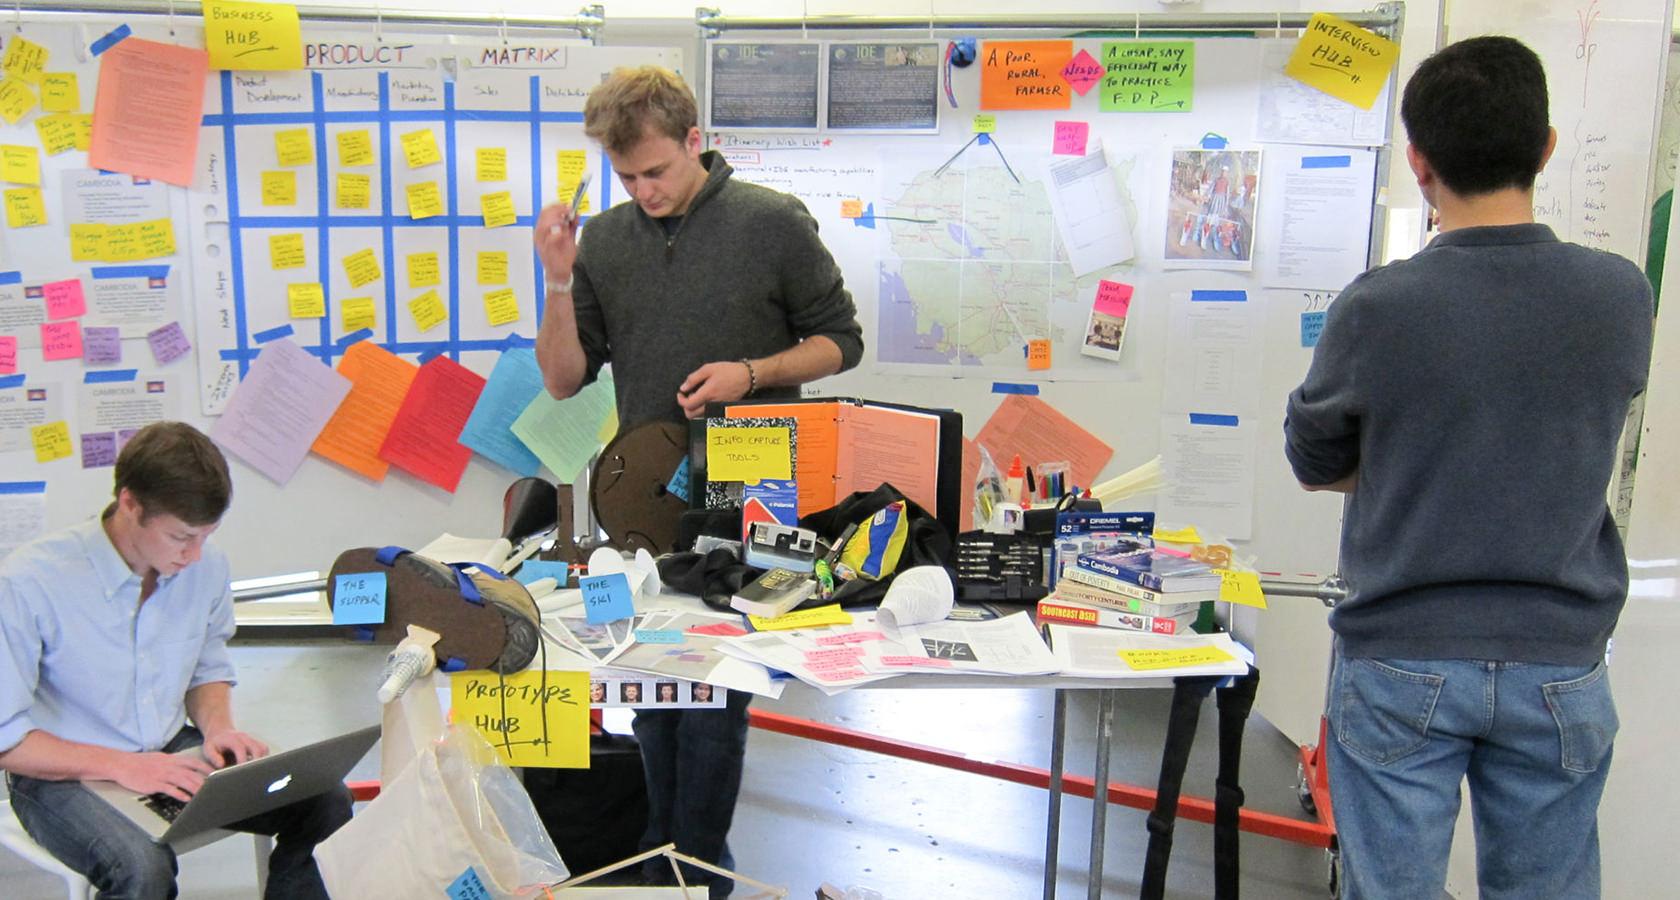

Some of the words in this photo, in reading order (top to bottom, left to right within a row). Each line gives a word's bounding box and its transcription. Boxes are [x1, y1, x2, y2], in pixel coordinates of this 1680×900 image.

[225, 30, 261, 45] HUB
[1313, 20, 1381, 57] INTERVIEW
[304, 44, 414, 66] PRODUCT
[481, 47, 560, 65] MATRIX
[988, 50, 998, 66] A
[1108, 47, 1117, 57] A
[1311, 44, 1353, 68] HUB
[1064, 61, 1100, 76] NEEDS
[1162, 63, 1188, 76] WAY
[1106, 77, 1117, 87] TO
[1015, 85, 1062, 96] FARMER
[724, 134, 771, 149] Itinerary
[776, 136, 798, 147] Wish
[802, 135, 820, 147] List
[727, 453, 761, 462] TOOLS
[1061, 524, 1072, 533] 52
[1090, 560, 1120, 576] Cambodia
[343, 580, 366, 590] THE
[586, 579, 610, 591] THE
[589, 595, 612, 607] SKI
[466, 680, 578, 705] PROTOTYPE
[475, 715, 520, 733] HUB
